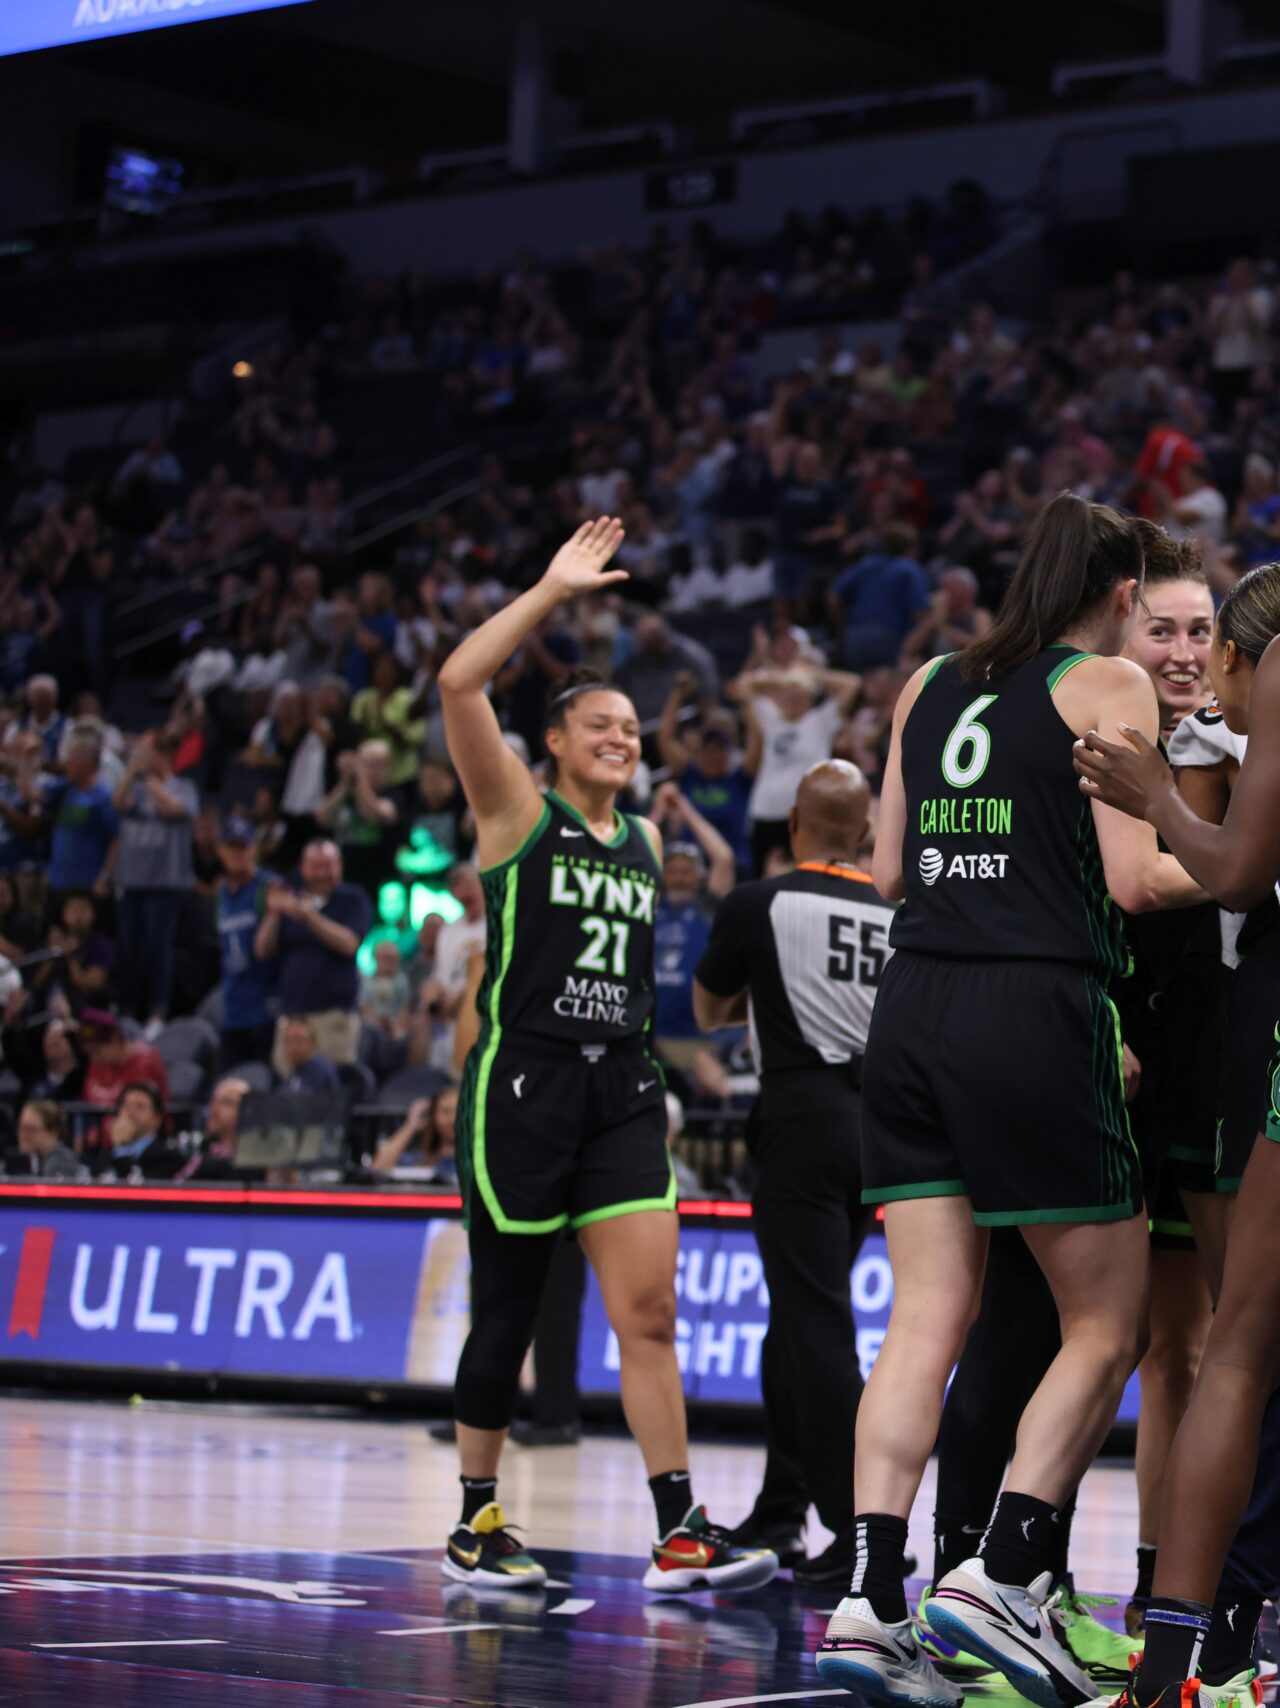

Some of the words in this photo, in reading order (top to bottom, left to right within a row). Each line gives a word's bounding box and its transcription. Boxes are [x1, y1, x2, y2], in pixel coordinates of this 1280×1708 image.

[941, 695, 999, 788] 6
[919, 798, 1012, 835] CARLETON
[550, 865, 656, 925] LYNX
[946, 853, 1009, 880] AT&T
[574, 915, 630, 977] 21
[828, 914, 887, 987] 55
[553, 996, 629, 1027] CLINIC
[564, 976, 629, 1004] MAYO
[70, 1244, 353, 1342] ULTRA
